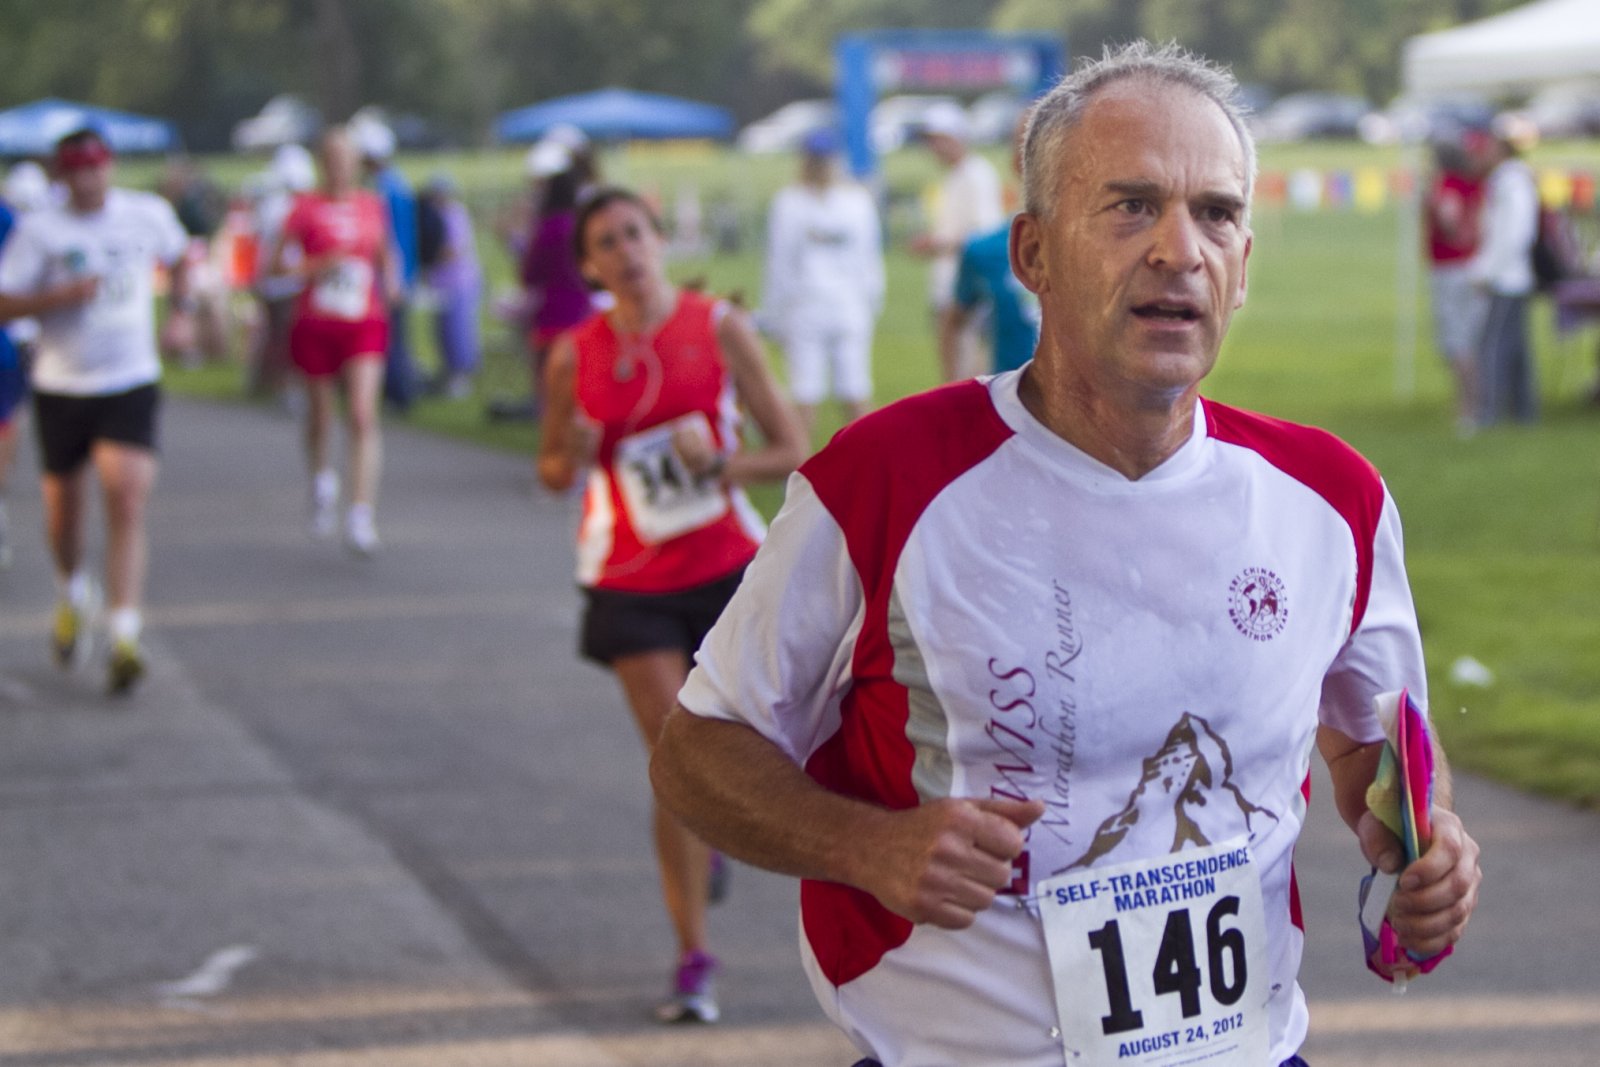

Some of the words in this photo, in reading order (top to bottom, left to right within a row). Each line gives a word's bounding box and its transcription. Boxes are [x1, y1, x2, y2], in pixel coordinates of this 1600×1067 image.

[1243, 567, 1285, 590] CHINMOY
[1044, 578, 1084, 684] Runner
[1228, 608, 1273, 642] MARATHON
[1275, 608, 1288, 634] TEAM
[984, 656, 1037, 844] WISS
[1037, 699, 1077, 846] Marathon
[1055, 847, 1250, 905] SELF-TRANSCENDENCE
[1113, 876, 1217, 914] MARATHON
[1087, 894, 1249, 1036] 146
[1117, 1030, 1181, 1060] AUGUST
[1185, 1024, 1210, 1043] 24,
[1212, 1011, 1244, 1037] 2012
